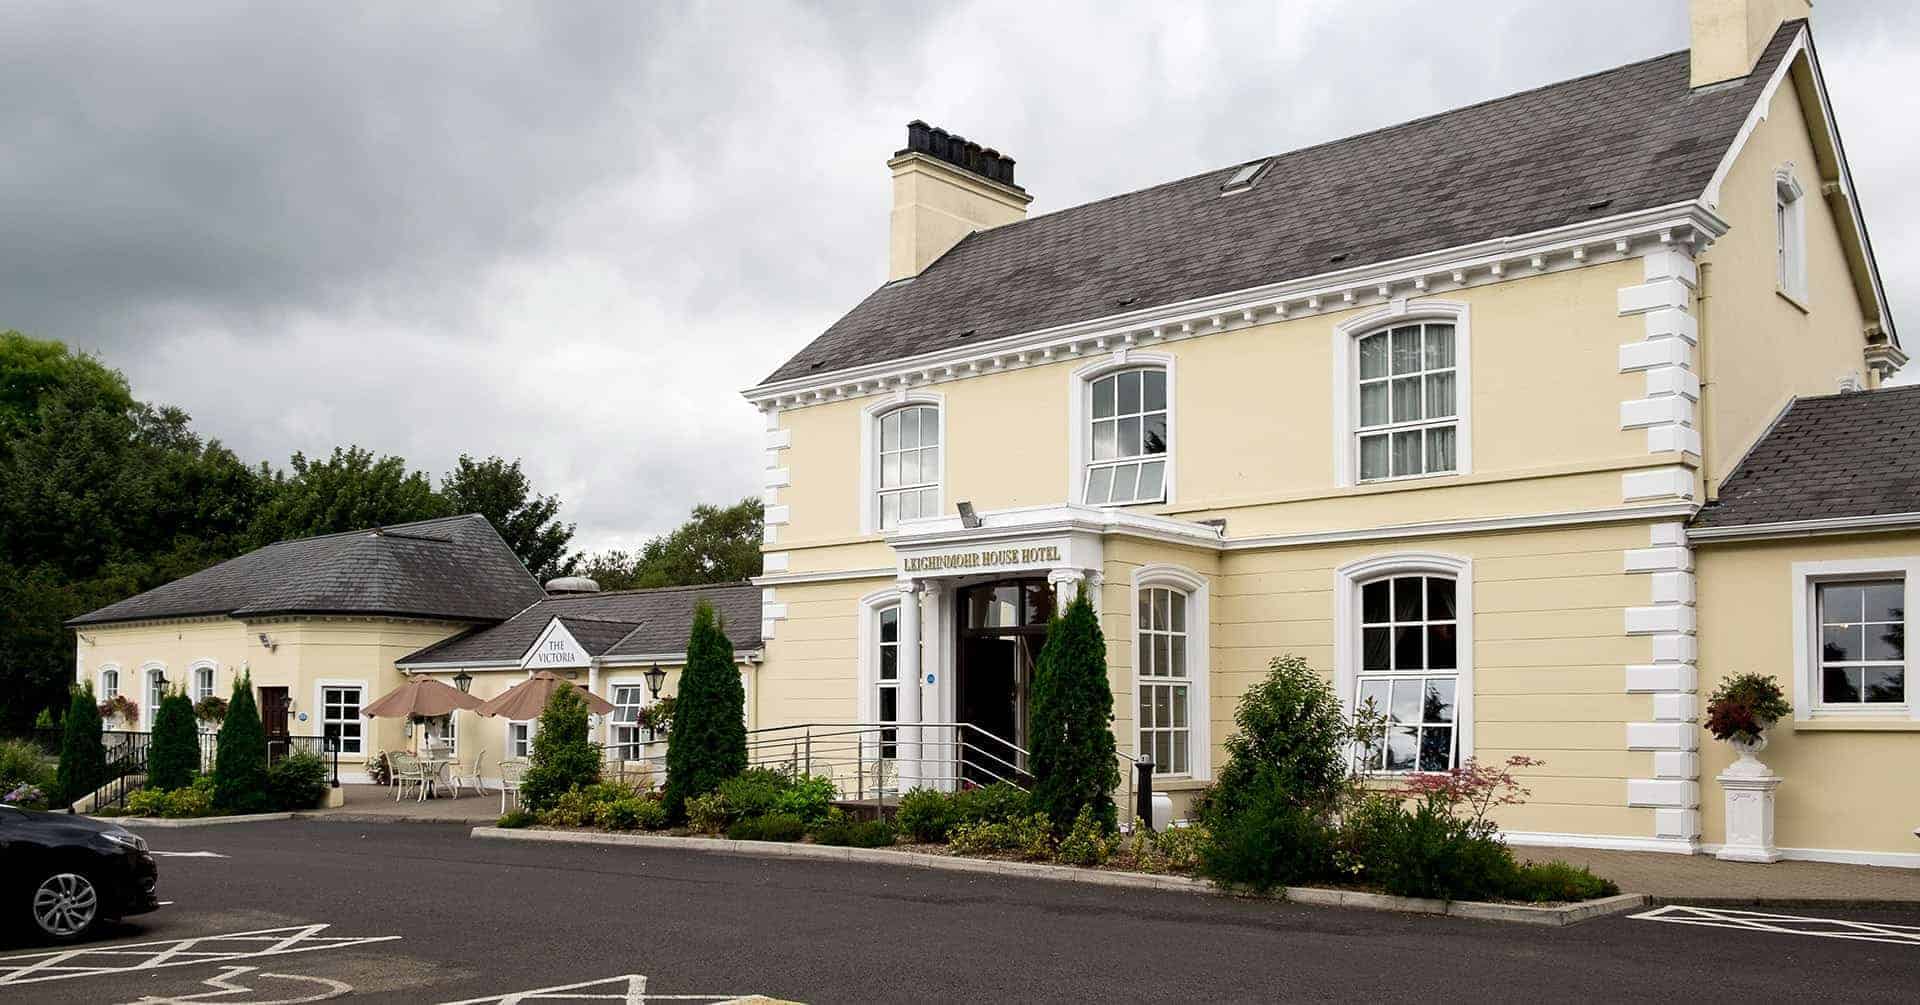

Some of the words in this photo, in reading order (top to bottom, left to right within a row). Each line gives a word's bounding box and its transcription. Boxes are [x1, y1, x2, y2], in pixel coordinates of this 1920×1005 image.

[982, 549, 1019, 566] HOUSE
[1021, 546, 1060, 563] HOTEL
[549, 640, 564, 650] THE
[538, 651, 576, 663] VICTORIA
